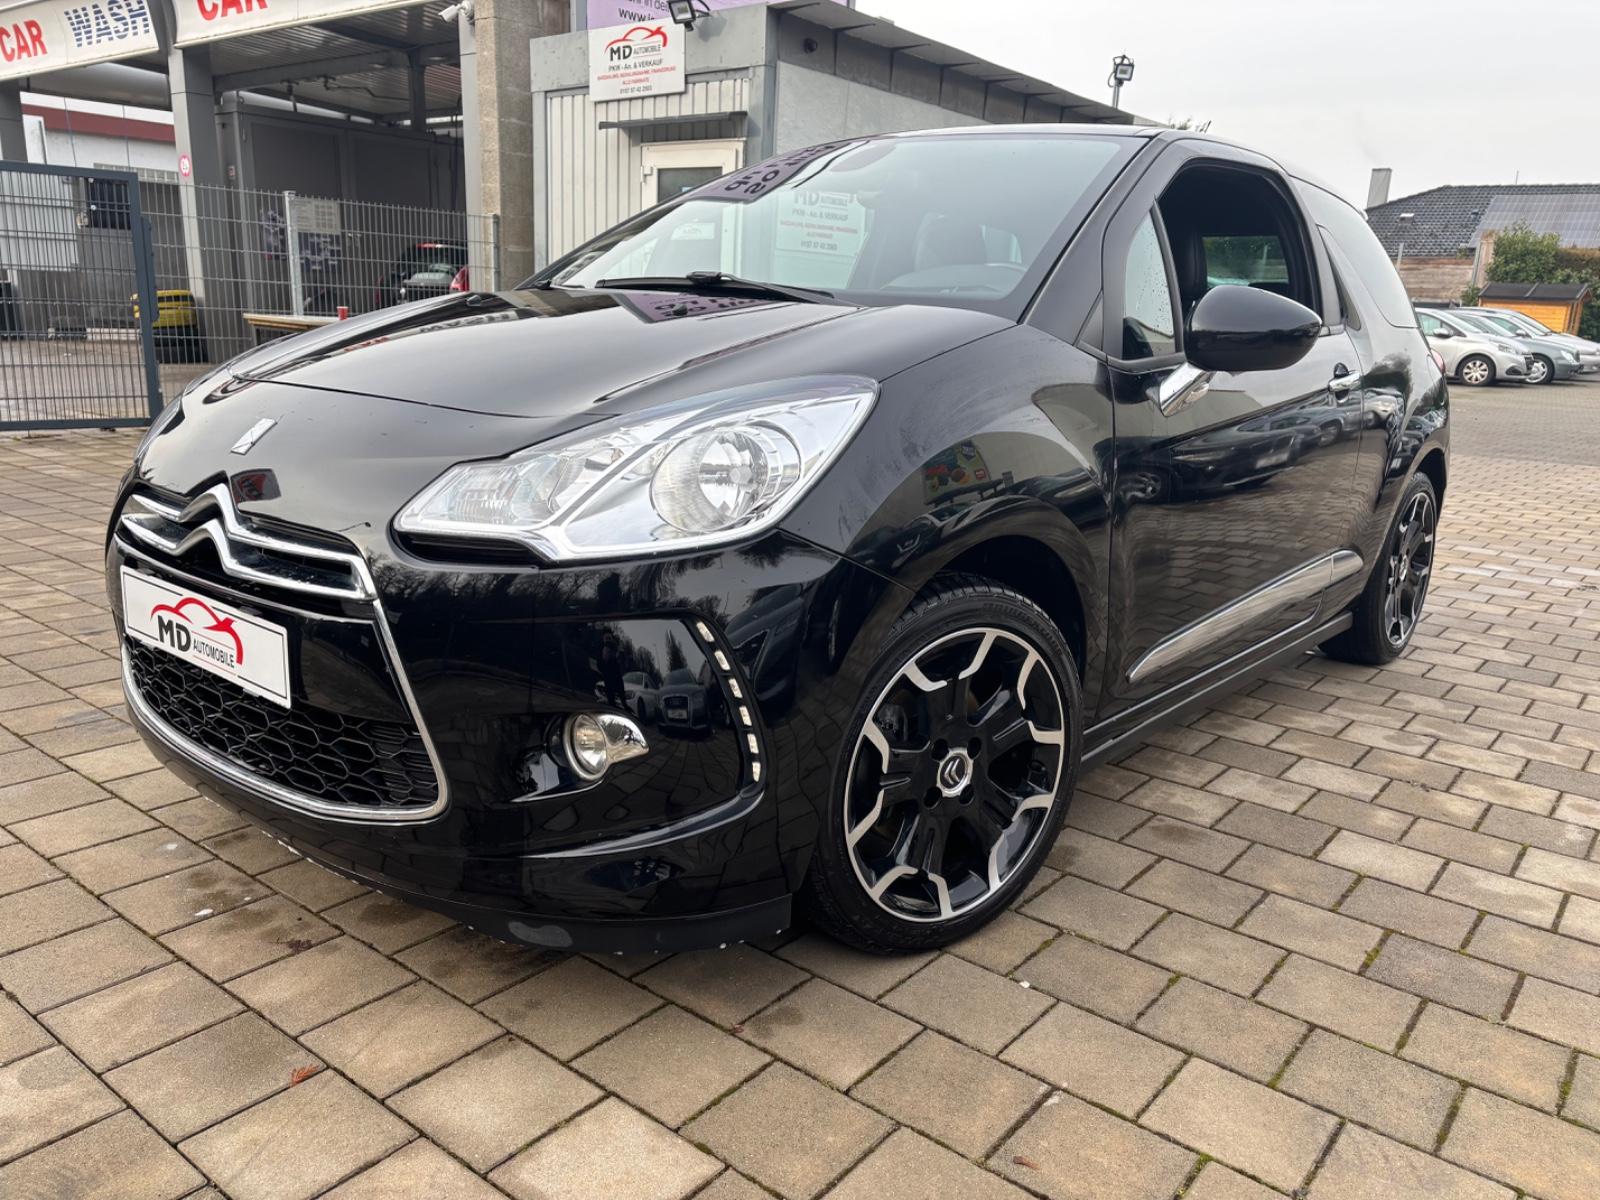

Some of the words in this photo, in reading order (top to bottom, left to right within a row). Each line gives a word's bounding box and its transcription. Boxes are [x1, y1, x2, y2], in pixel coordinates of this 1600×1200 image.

[0, 20, 48, 62] CAR
[64, 0, 149, 47] WASH
[610, 45, 632, 61] MD
[633, 44, 661, 55] AUTOMOBILE
[638, 58, 663, 68] VERKAUF
[157, 615, 191, 652] MD
[193, 638, 235, 668] AUTOMOBILE
